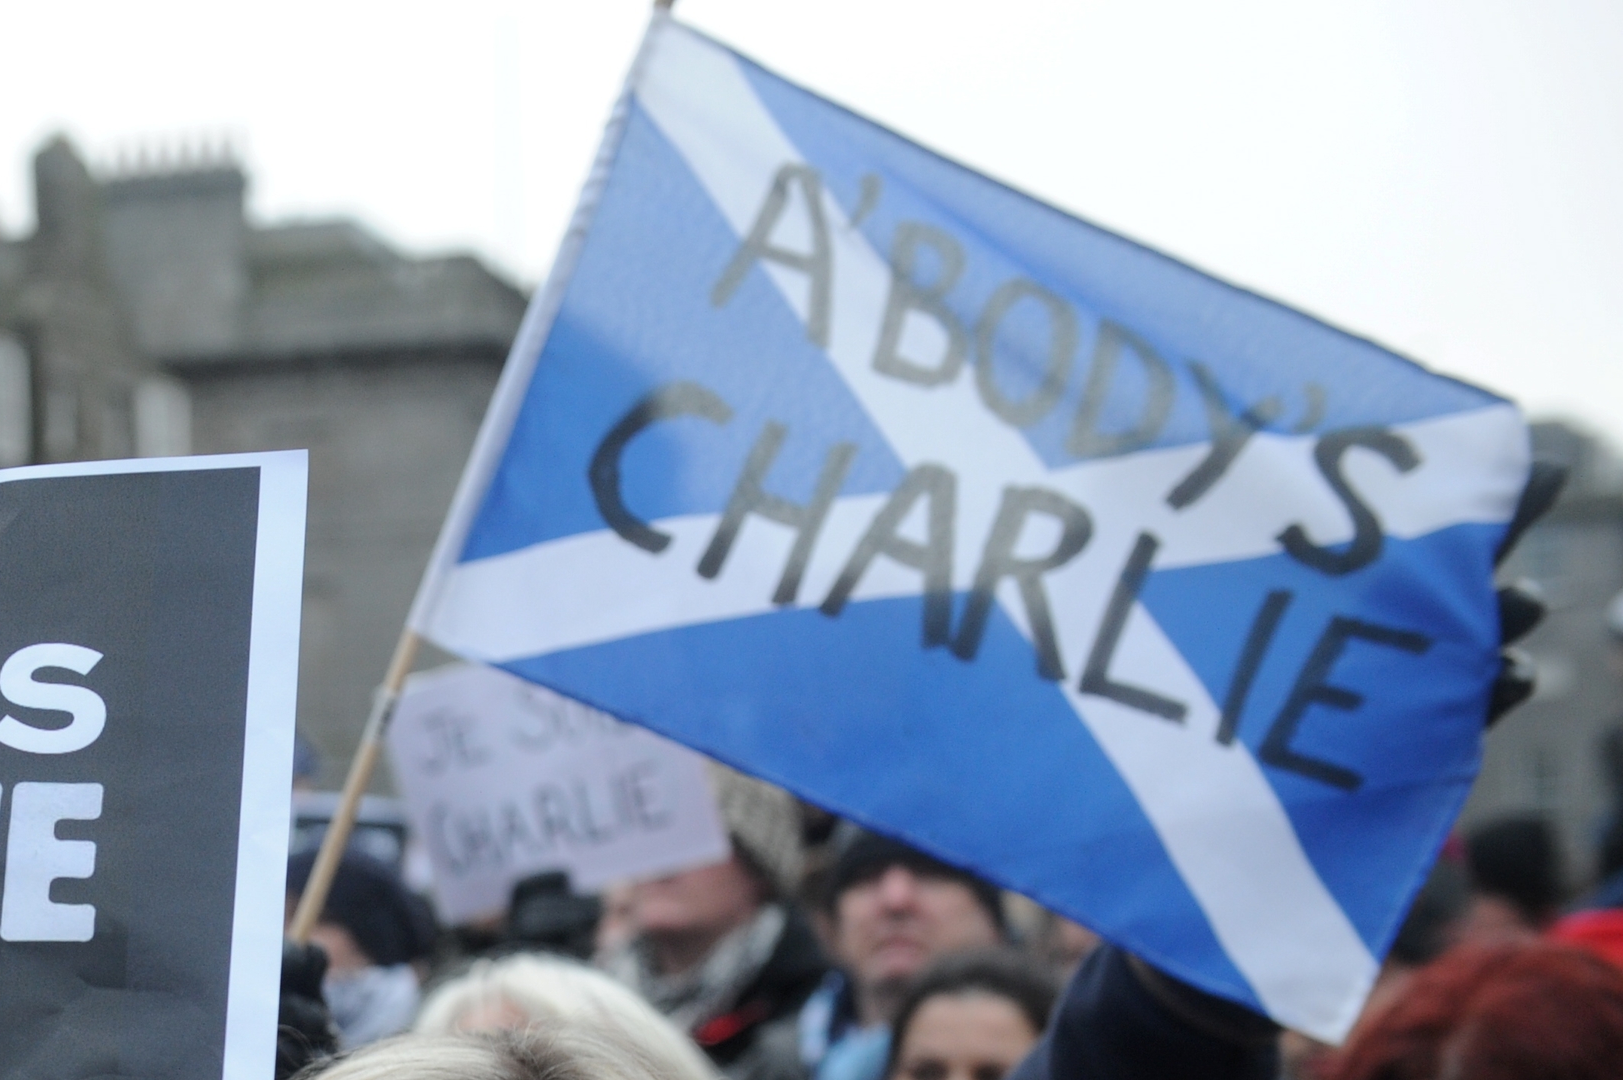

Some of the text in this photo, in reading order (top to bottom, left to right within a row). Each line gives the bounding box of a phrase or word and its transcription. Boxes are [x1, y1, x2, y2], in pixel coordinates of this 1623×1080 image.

[709, 162, 1423, 578] A'BODY'S
[588, 382, 1435, 793] CHARLIE
[419, 705, 492, 778] JE
[429, 757, 674, 877] CHARLIE
